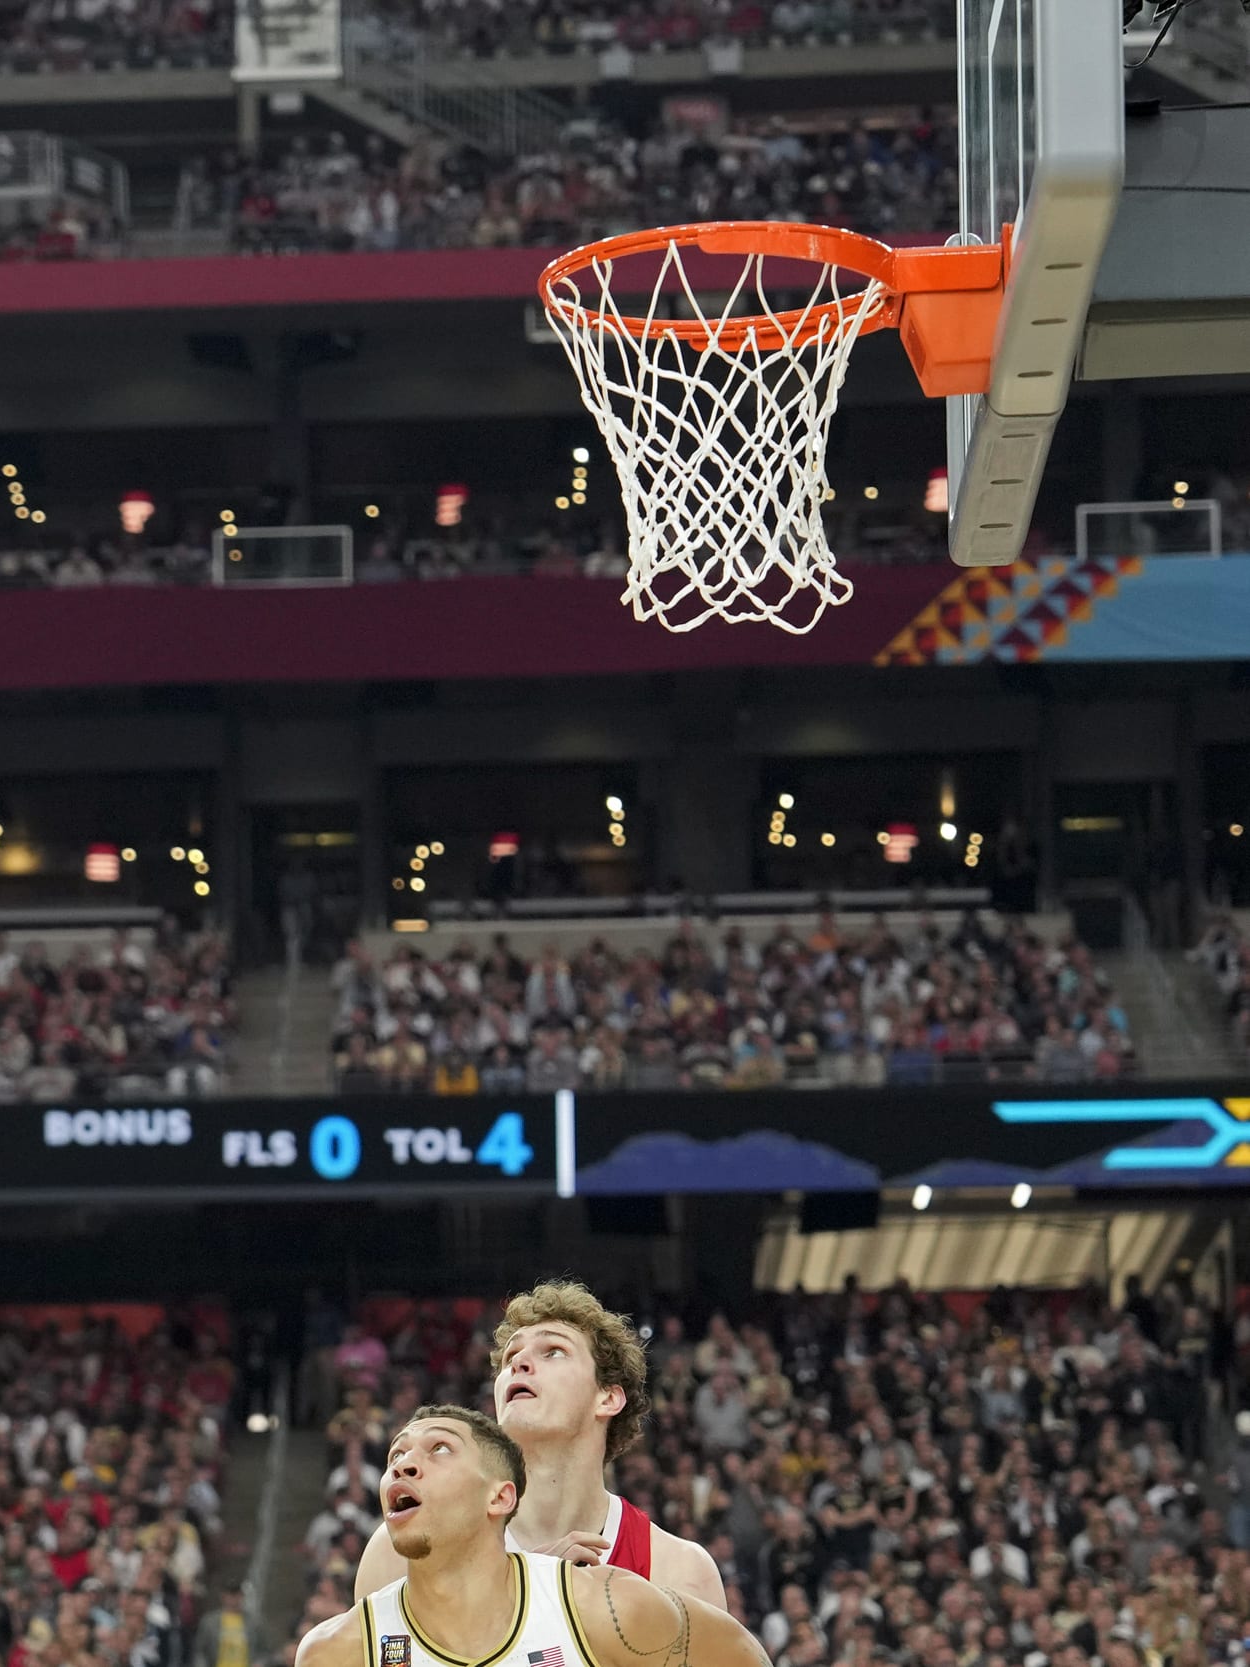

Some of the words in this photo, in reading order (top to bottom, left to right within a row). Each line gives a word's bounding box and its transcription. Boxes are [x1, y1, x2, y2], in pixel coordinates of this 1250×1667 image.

[44, 1109, 193, 1147] BONUS
[384, 1127, 473, 1165] TOL
[476, 1112, 534, 1176] 4
[222, 1130, 297, 1167] FLS
[309, 1115, 361, 1180] 0
[384, 1641, 405, 1651] FINAL
[384, 1650, 405, 1660] FOUR
